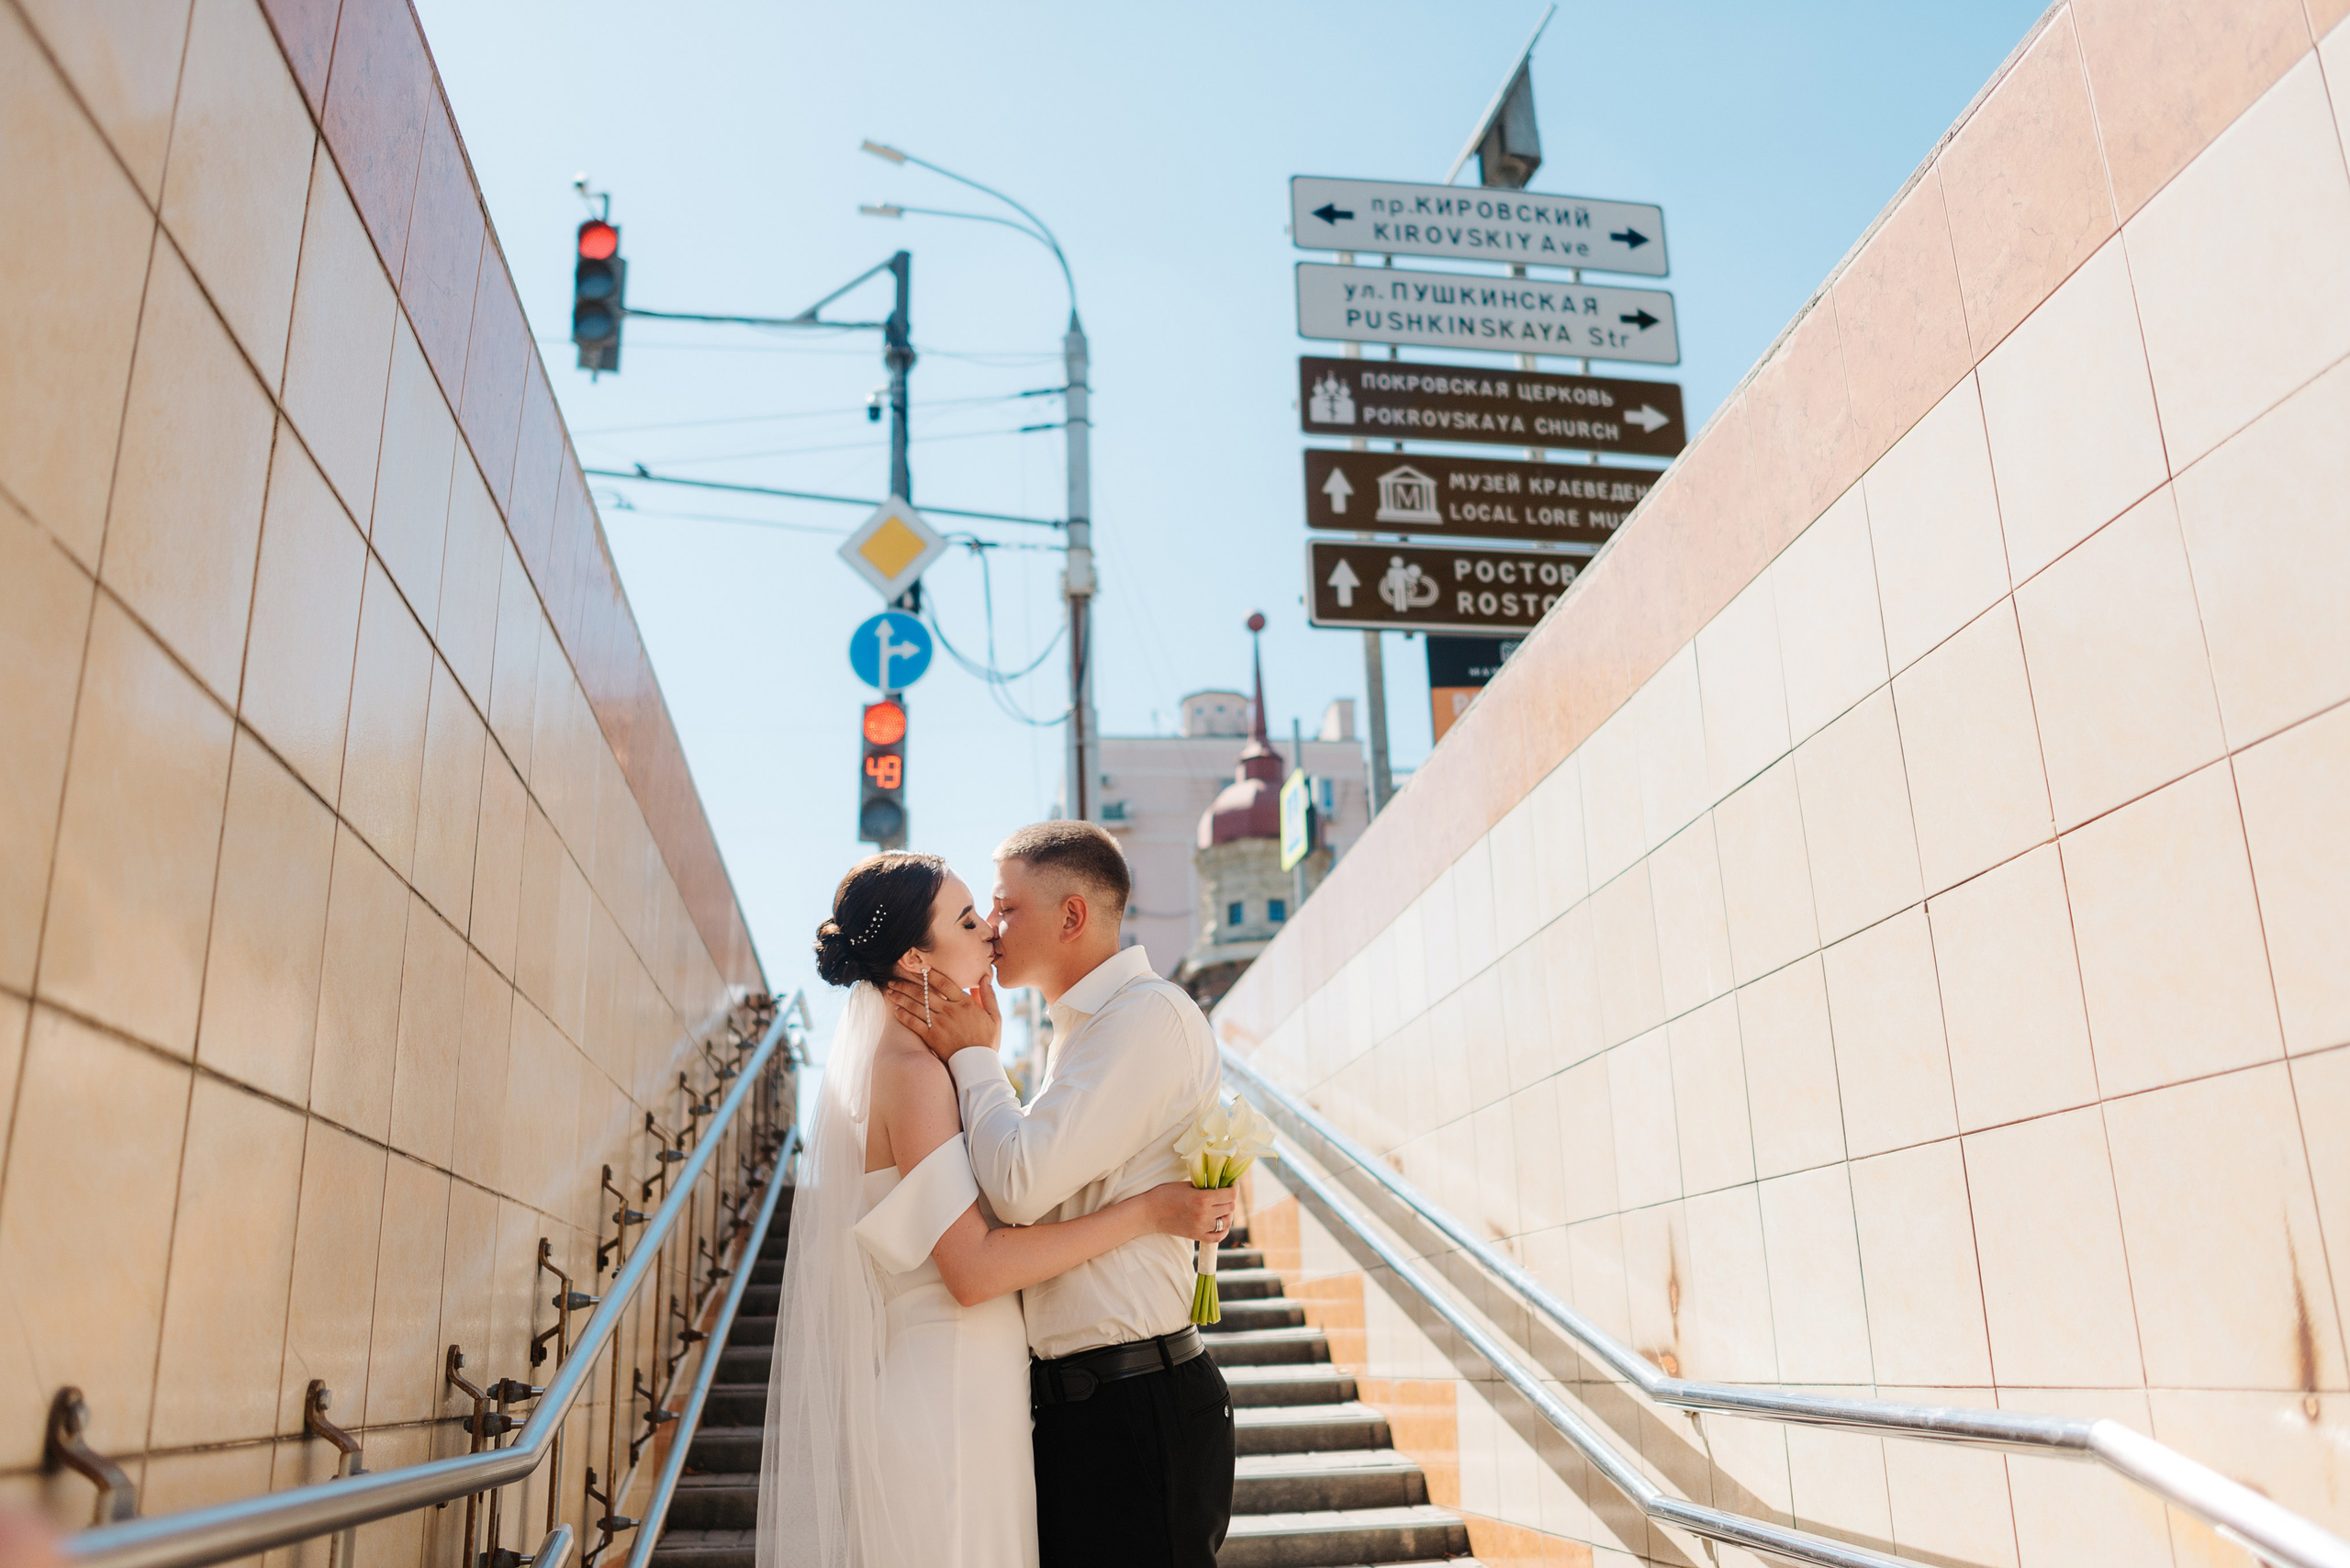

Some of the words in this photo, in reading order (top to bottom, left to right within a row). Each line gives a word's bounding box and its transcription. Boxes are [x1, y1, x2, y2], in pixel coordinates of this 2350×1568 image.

[1374, 223, 1531, 251] KIROVSKIY
[1541, 236, 1590, 257] Ave
[1347, 309, 1572, 343] PUSHKINSKAYA
[1589, 328, 1630, 348] Str
[1361, 373, 1509, 398] ПОКРОВСКАЯ
[1517, 383, 1614, 407] ЦЕРКОВЬ
[1363, 407, 1525, 433] POKROVSKAYA
[1535, 419, 1619, 441] CHURCH
[1449, 470, 1520, 494] МУЗЕЙ
[1529, 476, 1651, 502] КРАЕВЕДЕН
[1449, 502, 1518, 524] LOCAL
[1526, 508, 1580, 528] LORE
[1455, 559, 1576, 587] РОСТОВ
[866, 755, 901, 790] 49
